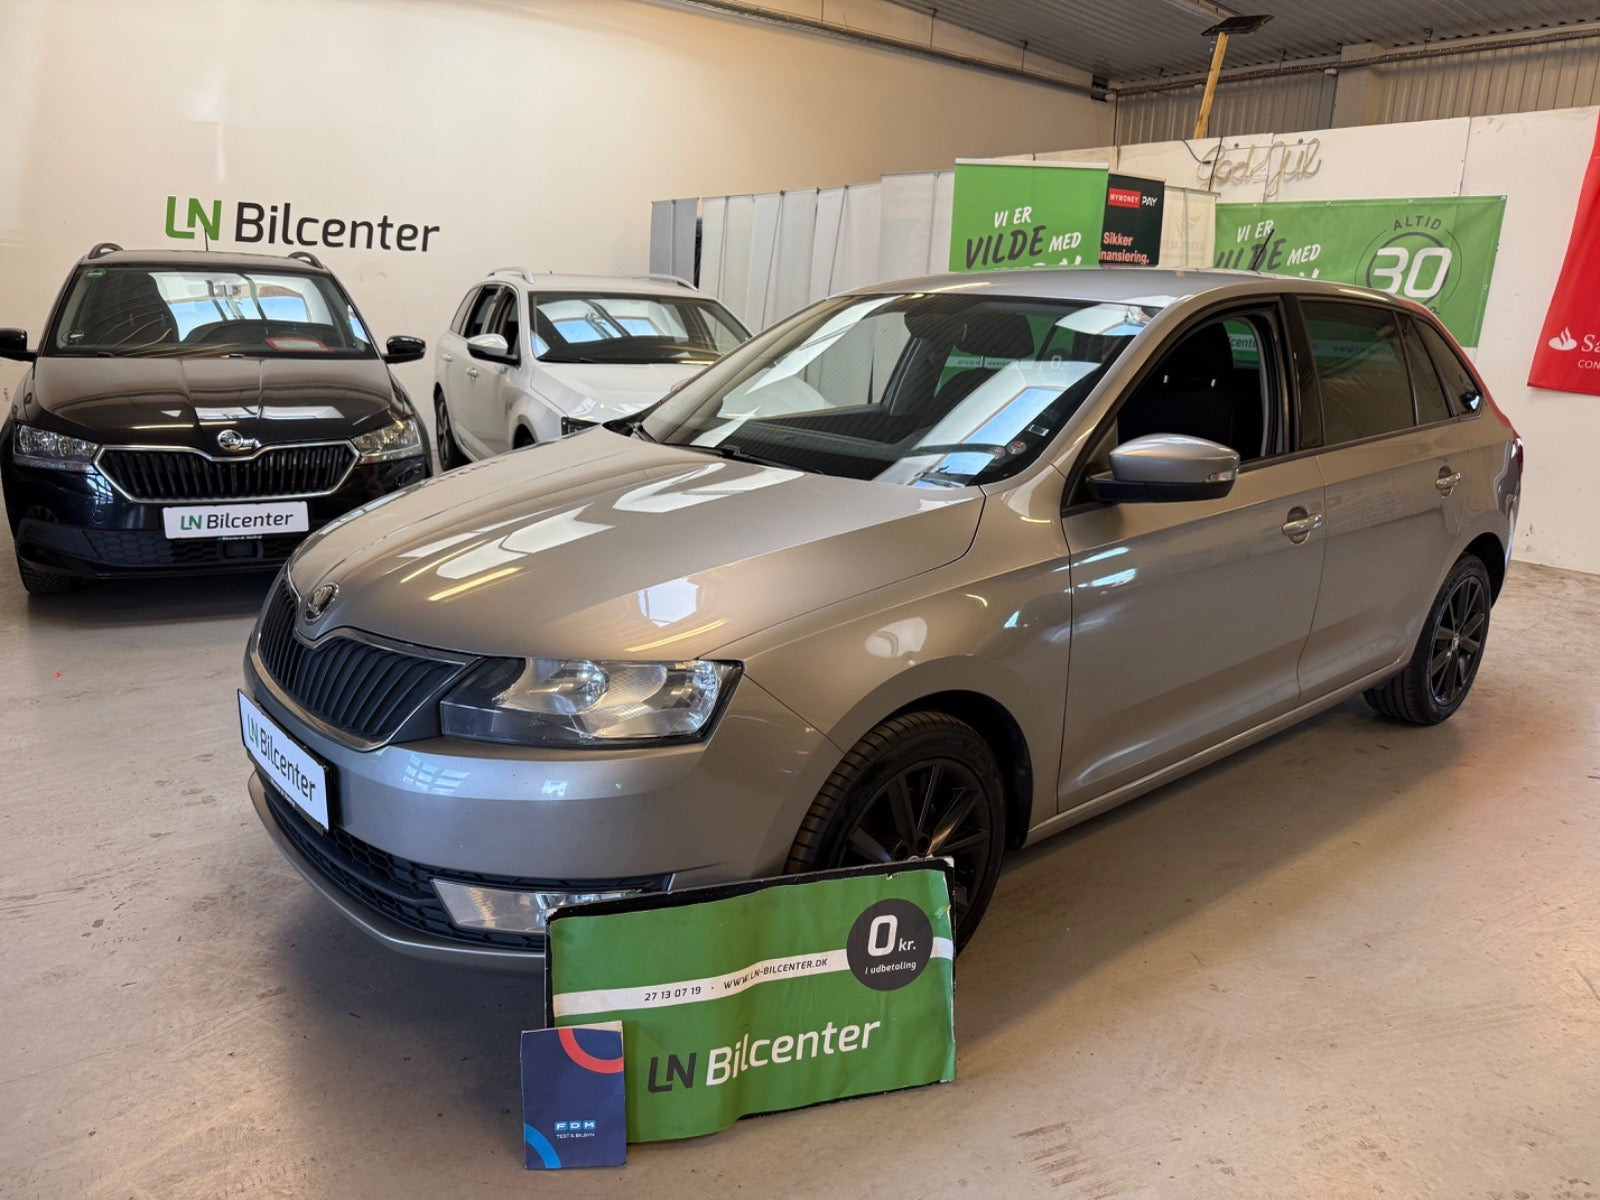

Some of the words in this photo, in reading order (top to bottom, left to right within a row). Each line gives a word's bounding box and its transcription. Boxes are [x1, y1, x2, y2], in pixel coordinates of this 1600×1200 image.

[1142, 196, 1157, 206] PAY
[165, 195, 222, 241] LN
[234, 201, 440, 252] Bilcenter
[994, 210, 1008, 228] VI
[1013, 206, 1032, 224] ER
[1393, 215, 1442, 231] ALTID
[1103, 231, 1133, 246] Sikker
[1236, 224, 1250, 243] VI
[1255, 219, 1274, 239] ER
[966, 225, 1046, 269] VILDE
[1048, 231, 1082, 253] MED
[1286, 243, 1321, 266] MED
[1373, 247, 1452, 298] 30
[180, 514, 203, 531] LN
[206, 512, 294, 530] Bilcenter
[247, 713, 259, 749] LN
[260, 727, 316, 802] Bilcenter
[867, 914, 898, 957] 0
[898, 937, 916, 952] kr.
[870, 961, 917, 974] udbetaling
[644, 992, 657, 1002] 27
[660, 990, 671, 1000] 13
[674, 988, 687, 998] 07
[690, 986, 701, 996] 19
[723, 957, 828, 990] WWW.LN-BILCENTER.DK
[647, 1052, 697, 1093] LN
[706, 1020, 881, 1086] Bilcenter
[556, 1121, 595, 1129] FDM
